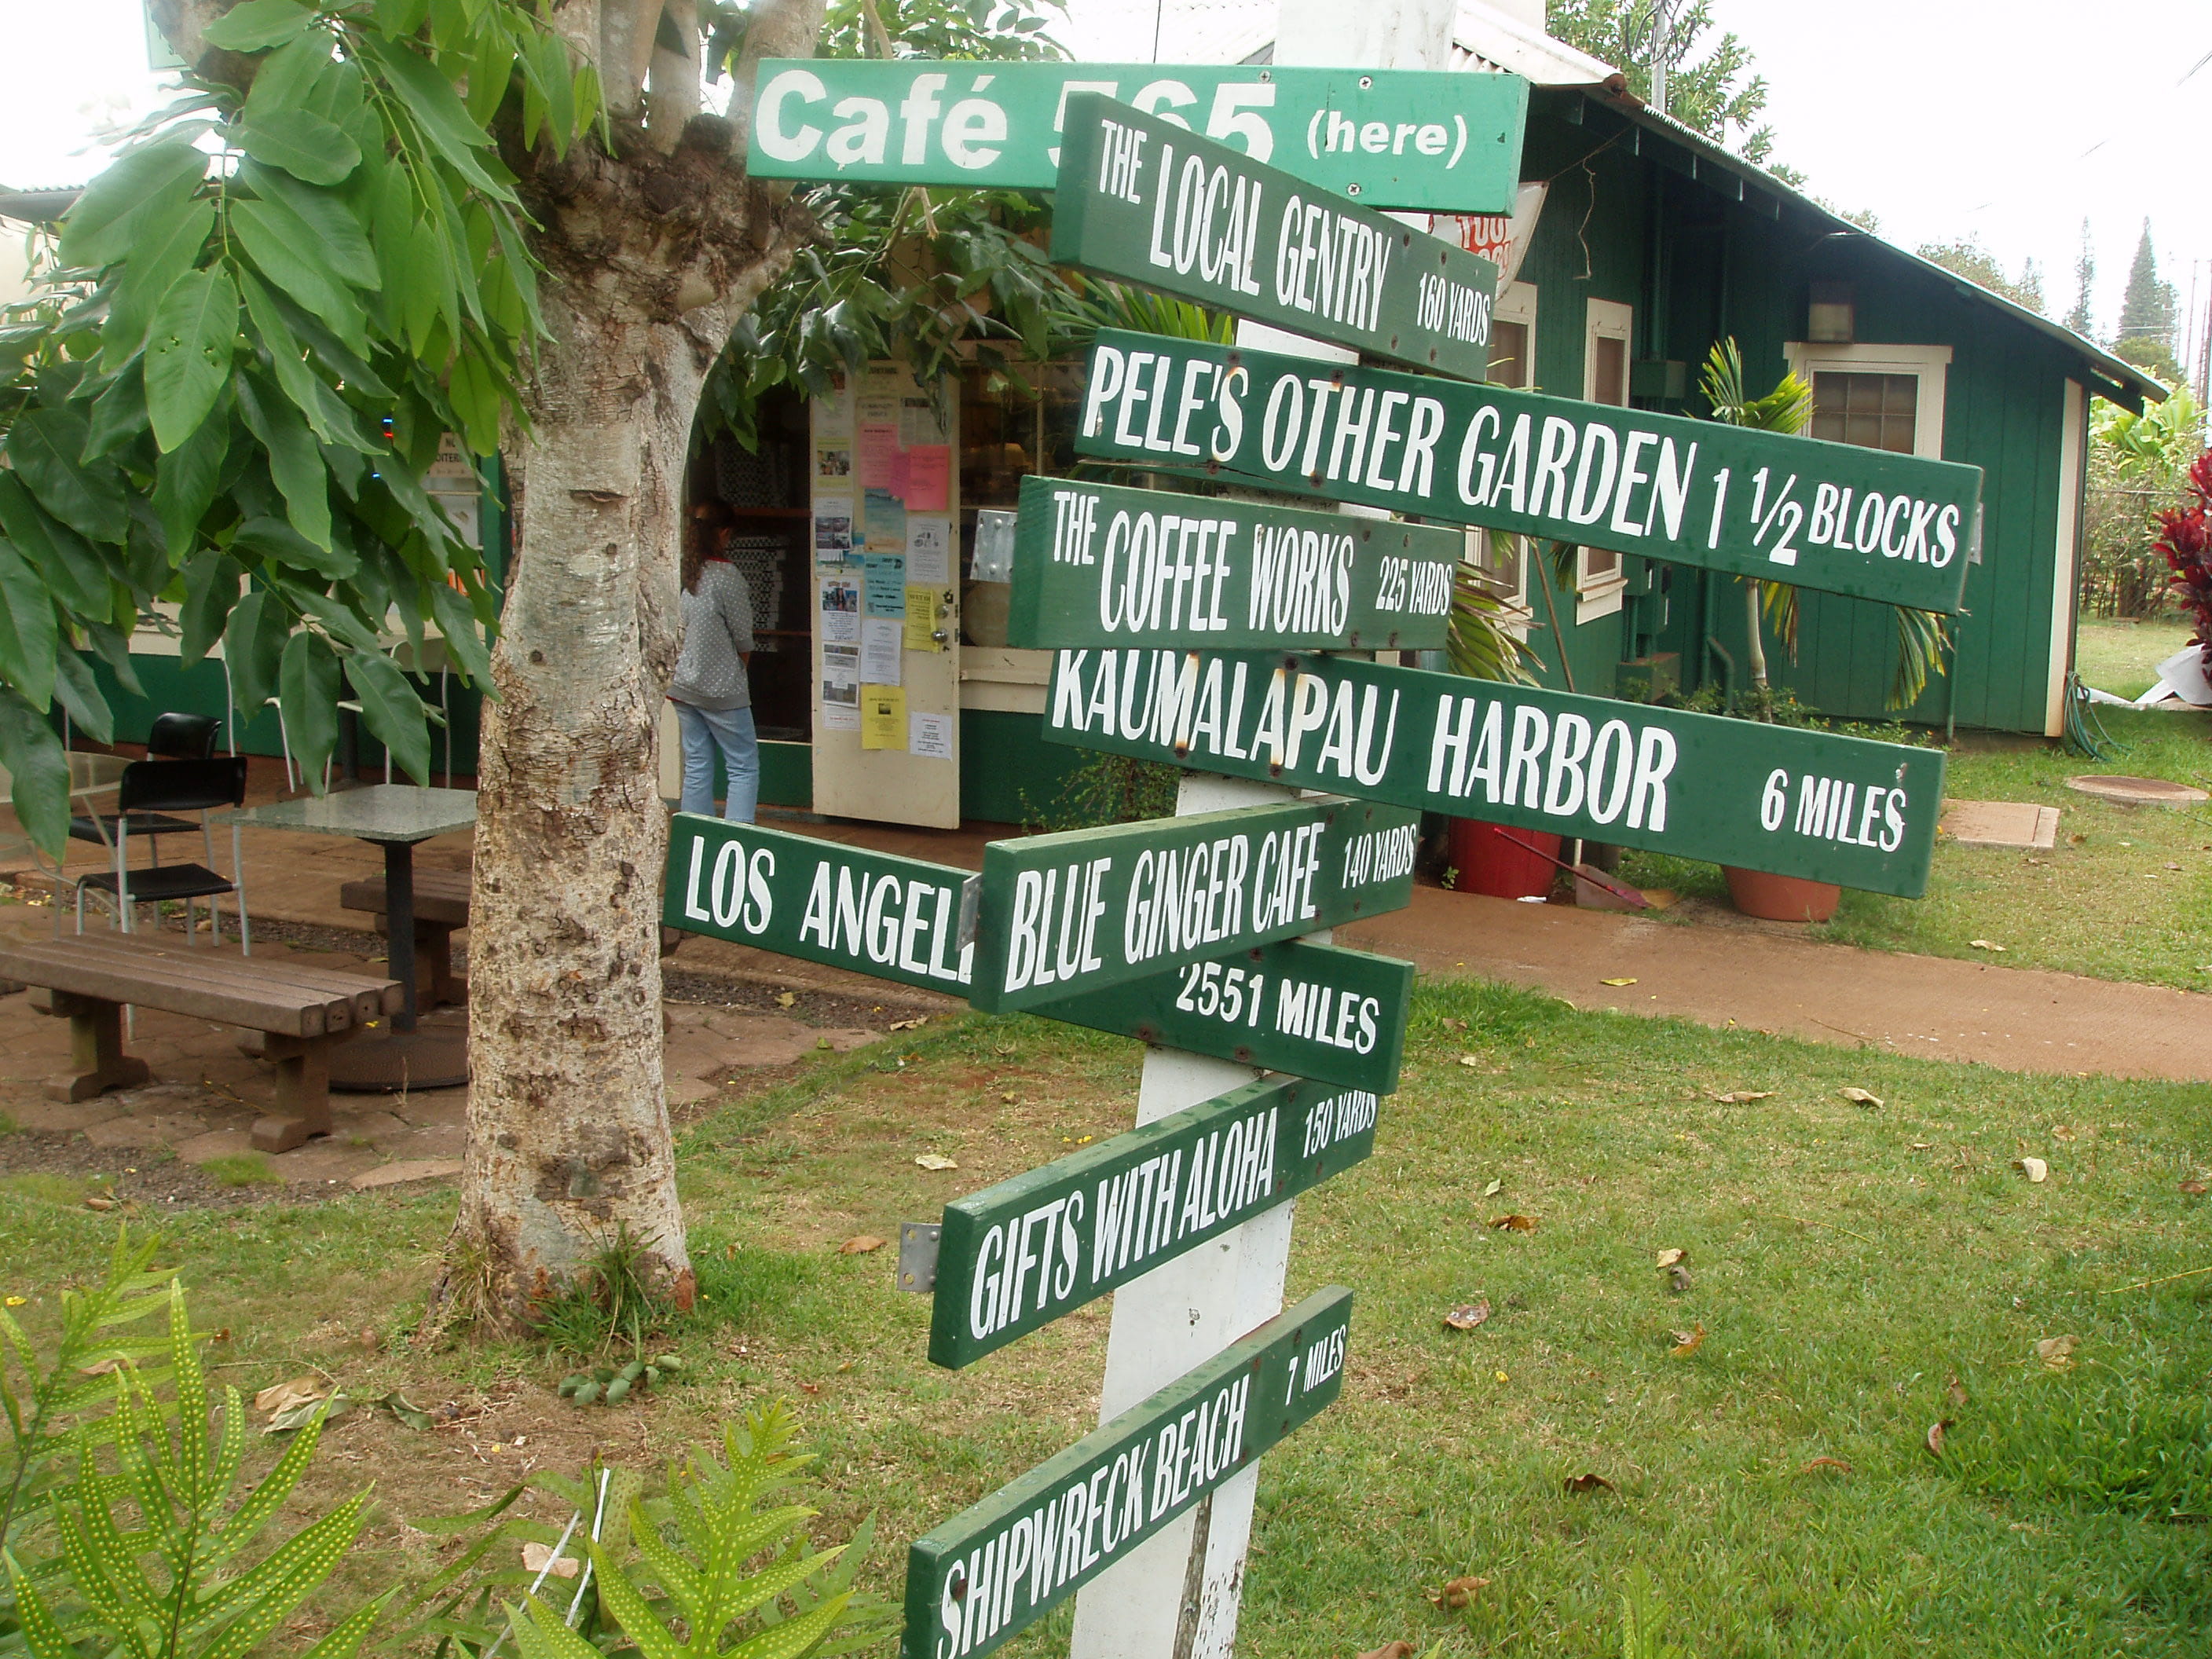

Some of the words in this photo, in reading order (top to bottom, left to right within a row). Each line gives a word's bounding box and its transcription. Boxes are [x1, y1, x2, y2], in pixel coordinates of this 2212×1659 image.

[754, 69, 1007, 170] Café
[1306, 109, 1467, 169] (here)
[1099, 119, 1147, 205] THE
[1149, 144, 1262, 295] LOCAL
[1275, 194, 1392, 332] GENTRY
[1415, 272, 1446, 332] 160
[1447, 281, 1491, 347] YARDS
[1053, 490, 1099, 566] THE
[1099, 510, 1237, 632] COFFEE
[1248, 523, 1354, 638] WORKS
[1375, 555, 1409, 613] 225
[1409, 560, 1453, 617] YARDS
[1082, 345, 1249, 463] PELE'S
[1262, 373, 1446, 498] OTHER
[1457, 405, 1698, 542] GARDEN
[1708, 468, 1731, 549] 1
[1807, 482, 1961, 569] BLOCKS
[1052, 649, 1400, 786] KAUMALAPAU
[1426, 694, 1679, 833] HARBOR
[1760, 767, 1789, 833] 6
[1795, 774, 1908, 852] MILES
[684, 835, 775, 936] LOS
[799, 861, 975, 985] ANGEL
[1176, 961, 1265, 1027] 2551
[1276, 978, 1380, 1055] MILES
[1005, 857, 1112, 994] BLUE
[1124, 833, 1250, 966] GINGER
[1253, 822, 1326, 934] CAFE
[1342, 836, 1371, 890] 140
[1371, 823, 1417, 881] YARDS
[969, 1189, 1086, 1340] GIFTS
[1092, 1149, 1181, 1284] WITH
[1178, 1107, 1278, 1240] ALOHA
[1302, 1097, 1334, 1159] 150
[1334, 1090, 1376, 1142] YARDS
[936, 1437, 1152, 1659] SHIPWRECK
[1149, 1373, 1251, 1522] BEACH
[1284, 1356, 1299, 1406] 7
[1302, 1324, 1347, 1393] MILES
